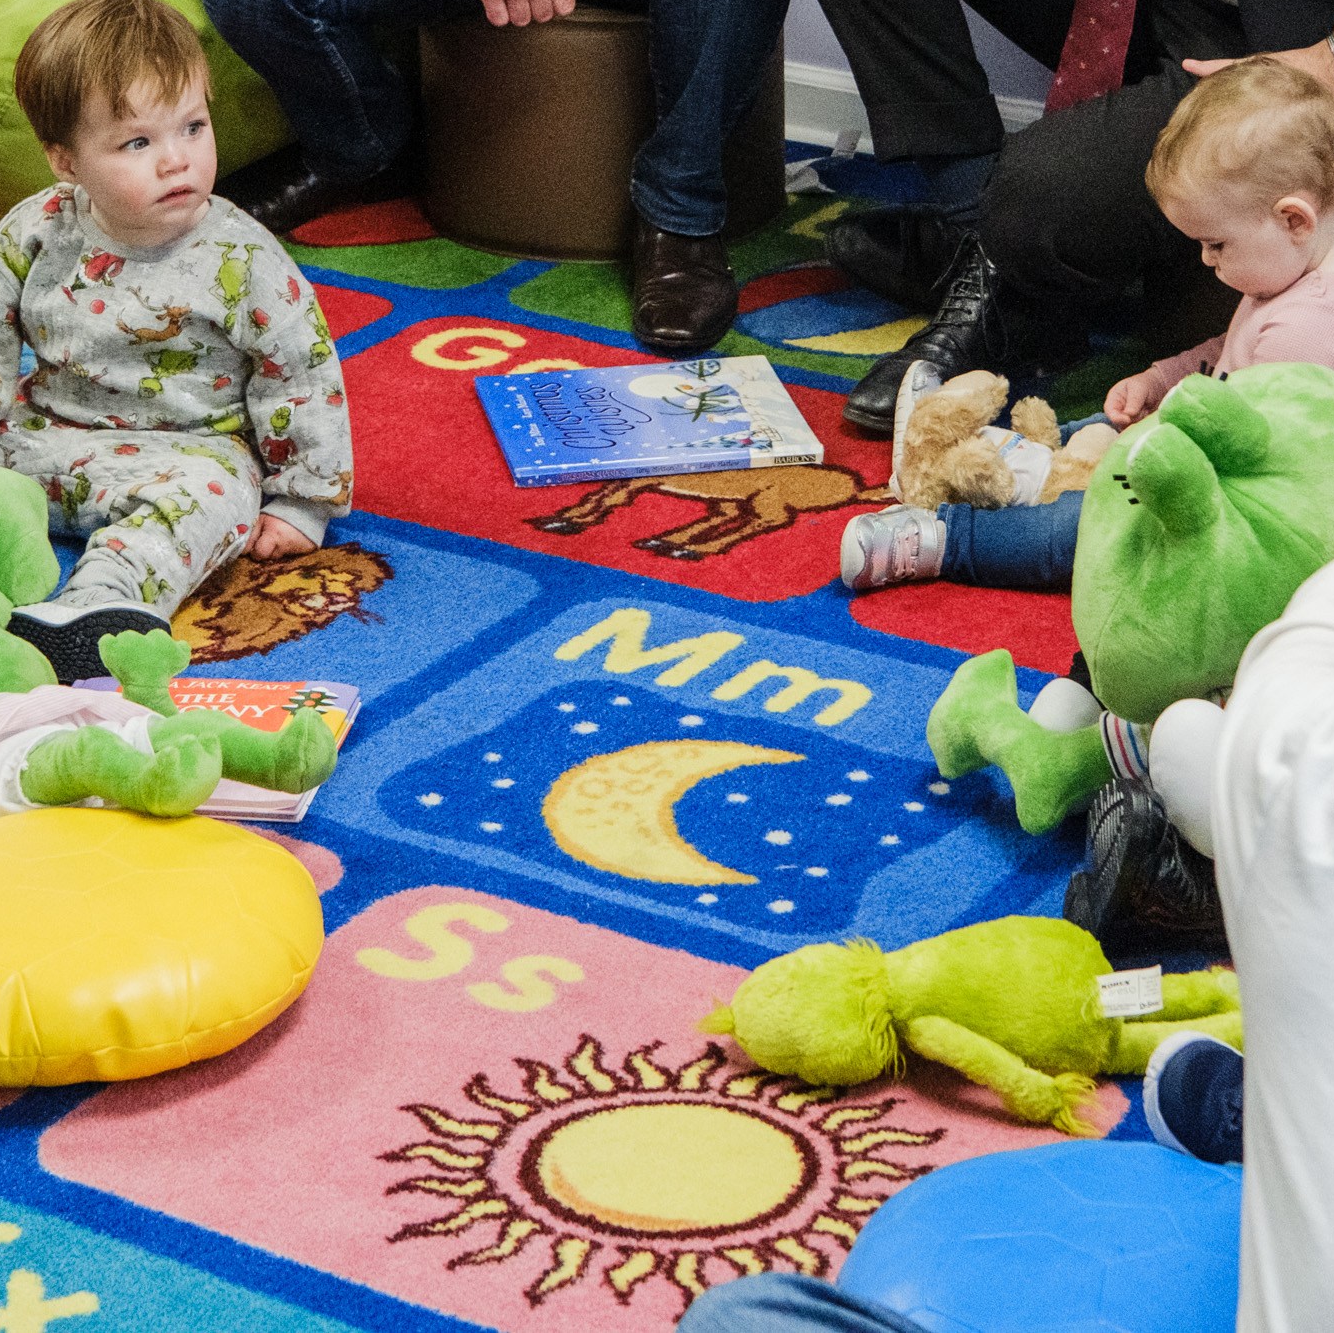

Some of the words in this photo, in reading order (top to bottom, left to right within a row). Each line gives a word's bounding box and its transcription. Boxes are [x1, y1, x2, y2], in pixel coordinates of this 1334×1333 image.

[530, 381, 617, 450] Christmas
[576, 385, 652, 437] Wishes
[773, 452, 817, 465] BARRON'S
[182, 680, 231, 689] JACK
[237, 681, 292, 691] KEATS
[554, 608, 873, 727] Mm
[174, 693, 237, 703] THE
[356, 902, 586, 1014] Ss
